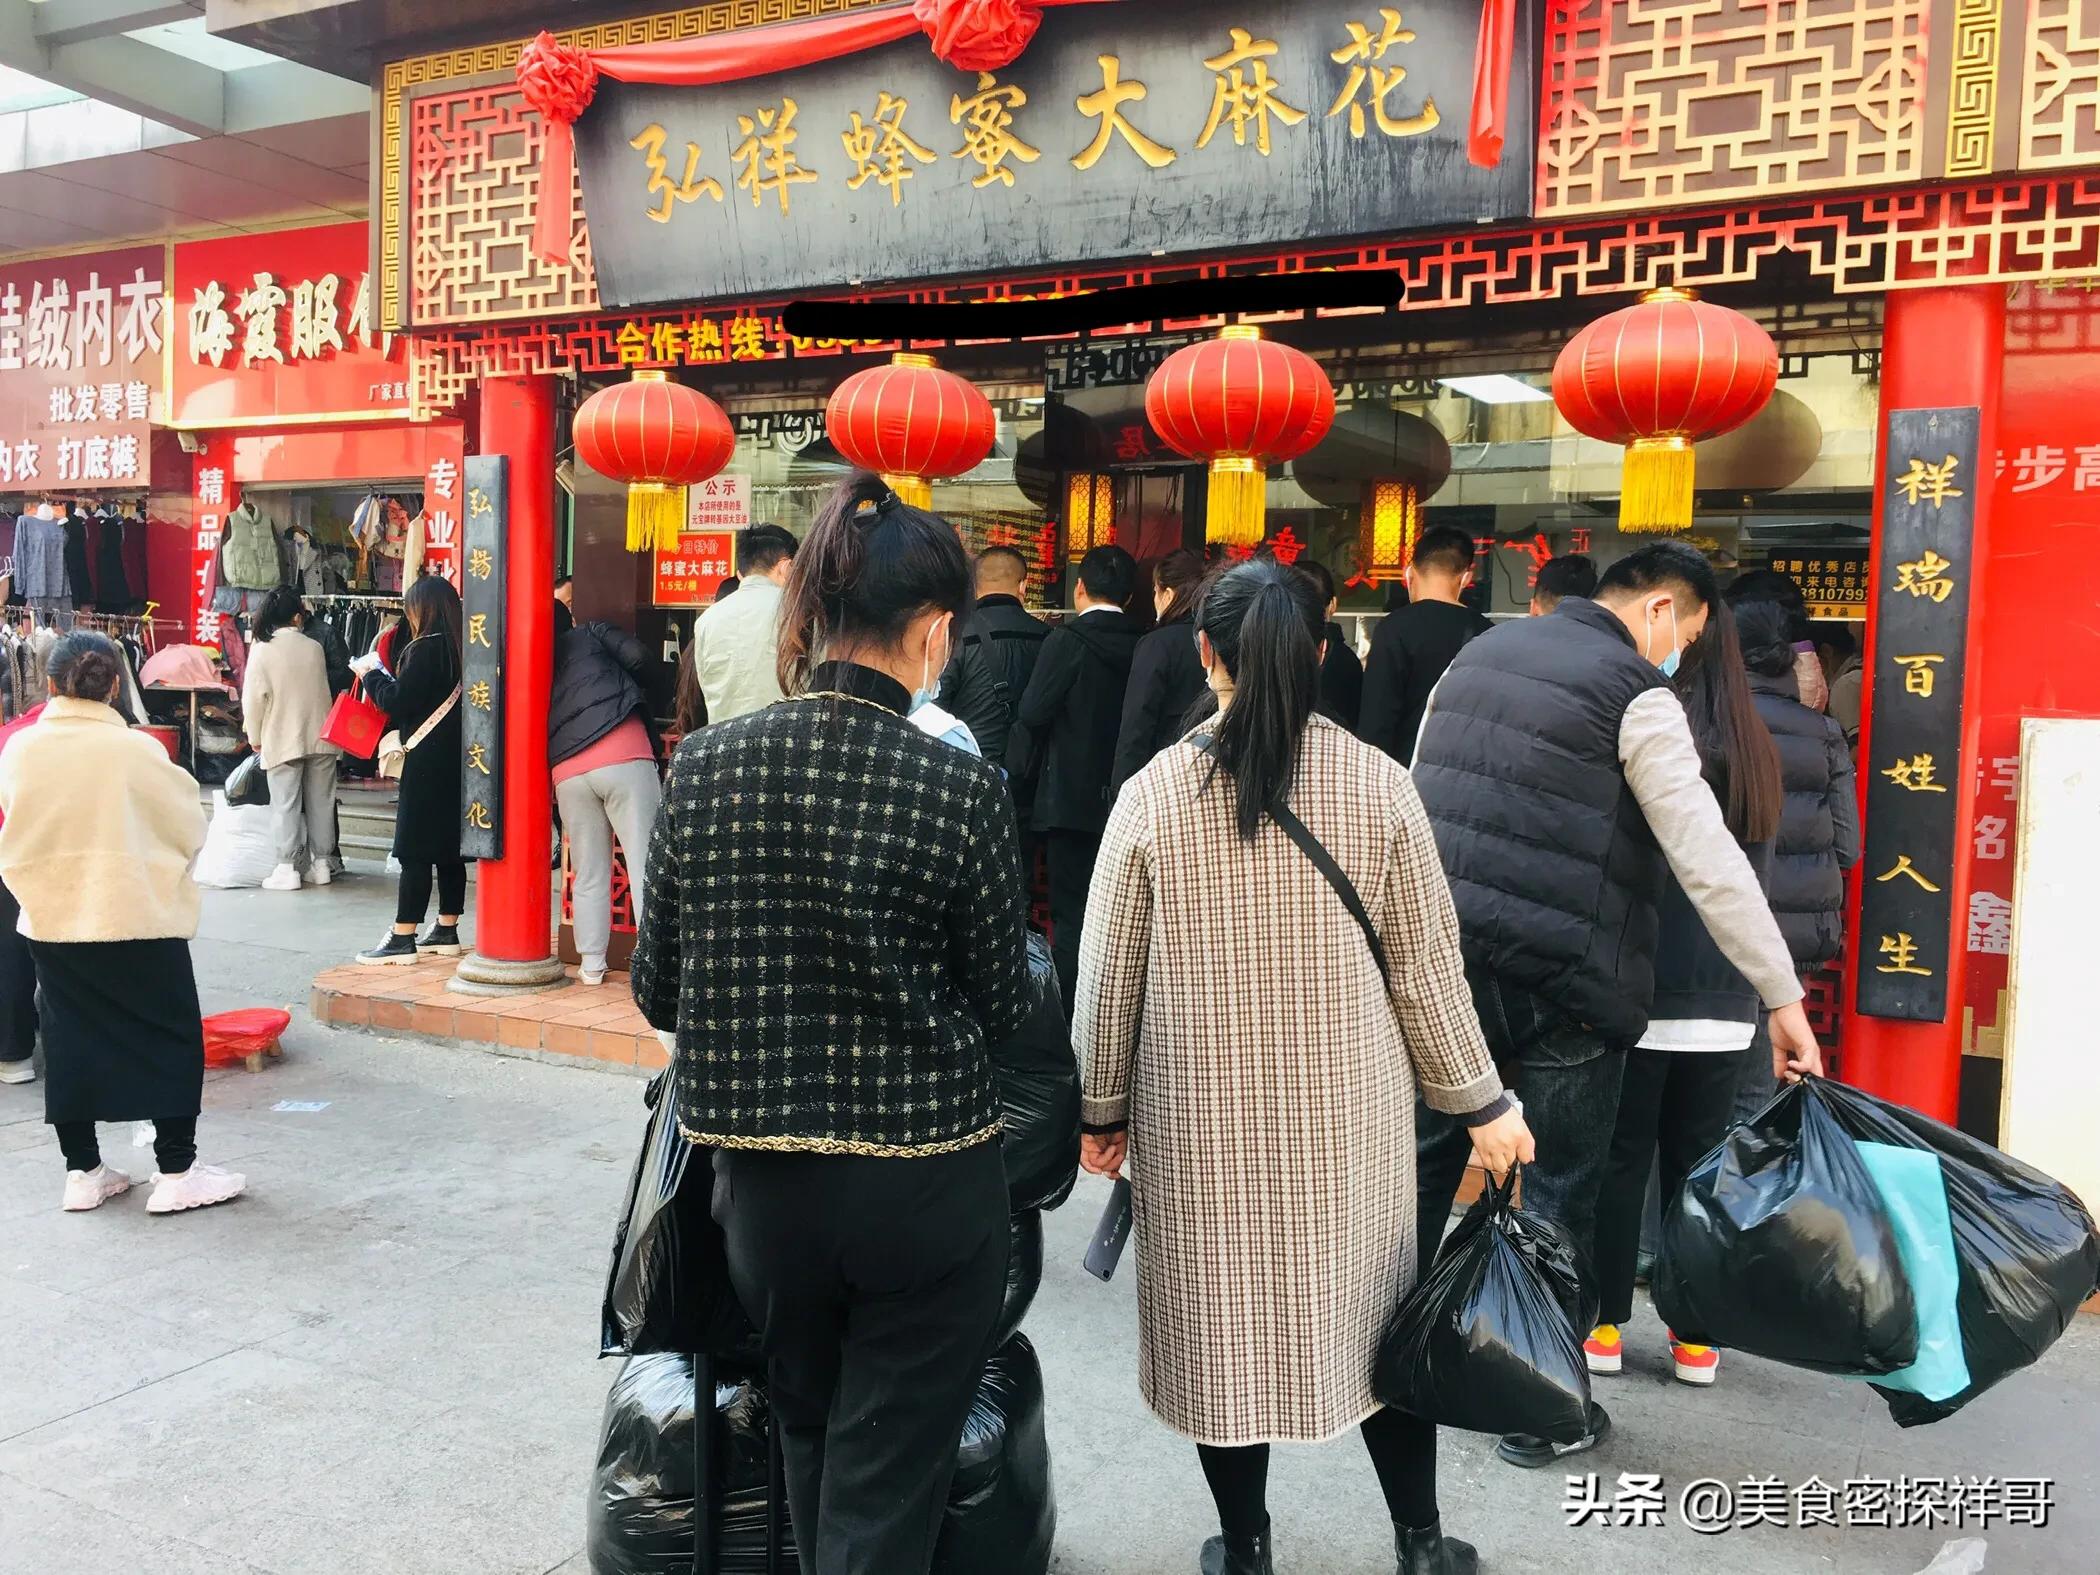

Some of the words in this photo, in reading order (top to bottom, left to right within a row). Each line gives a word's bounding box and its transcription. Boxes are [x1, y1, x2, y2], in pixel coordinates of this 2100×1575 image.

[629, 7, 1441, 224] 弘祥蜂蜜大麻花
[50, 381, 149, 422] 批发零售
[57, 434, 137, 480] 打底裤
[705, 480, 736, 496] 公示
[660, 560, 728, 576] 蜂蜜大麻花
[1876, 453, 1962, 976] 祥瑞百姓人生
